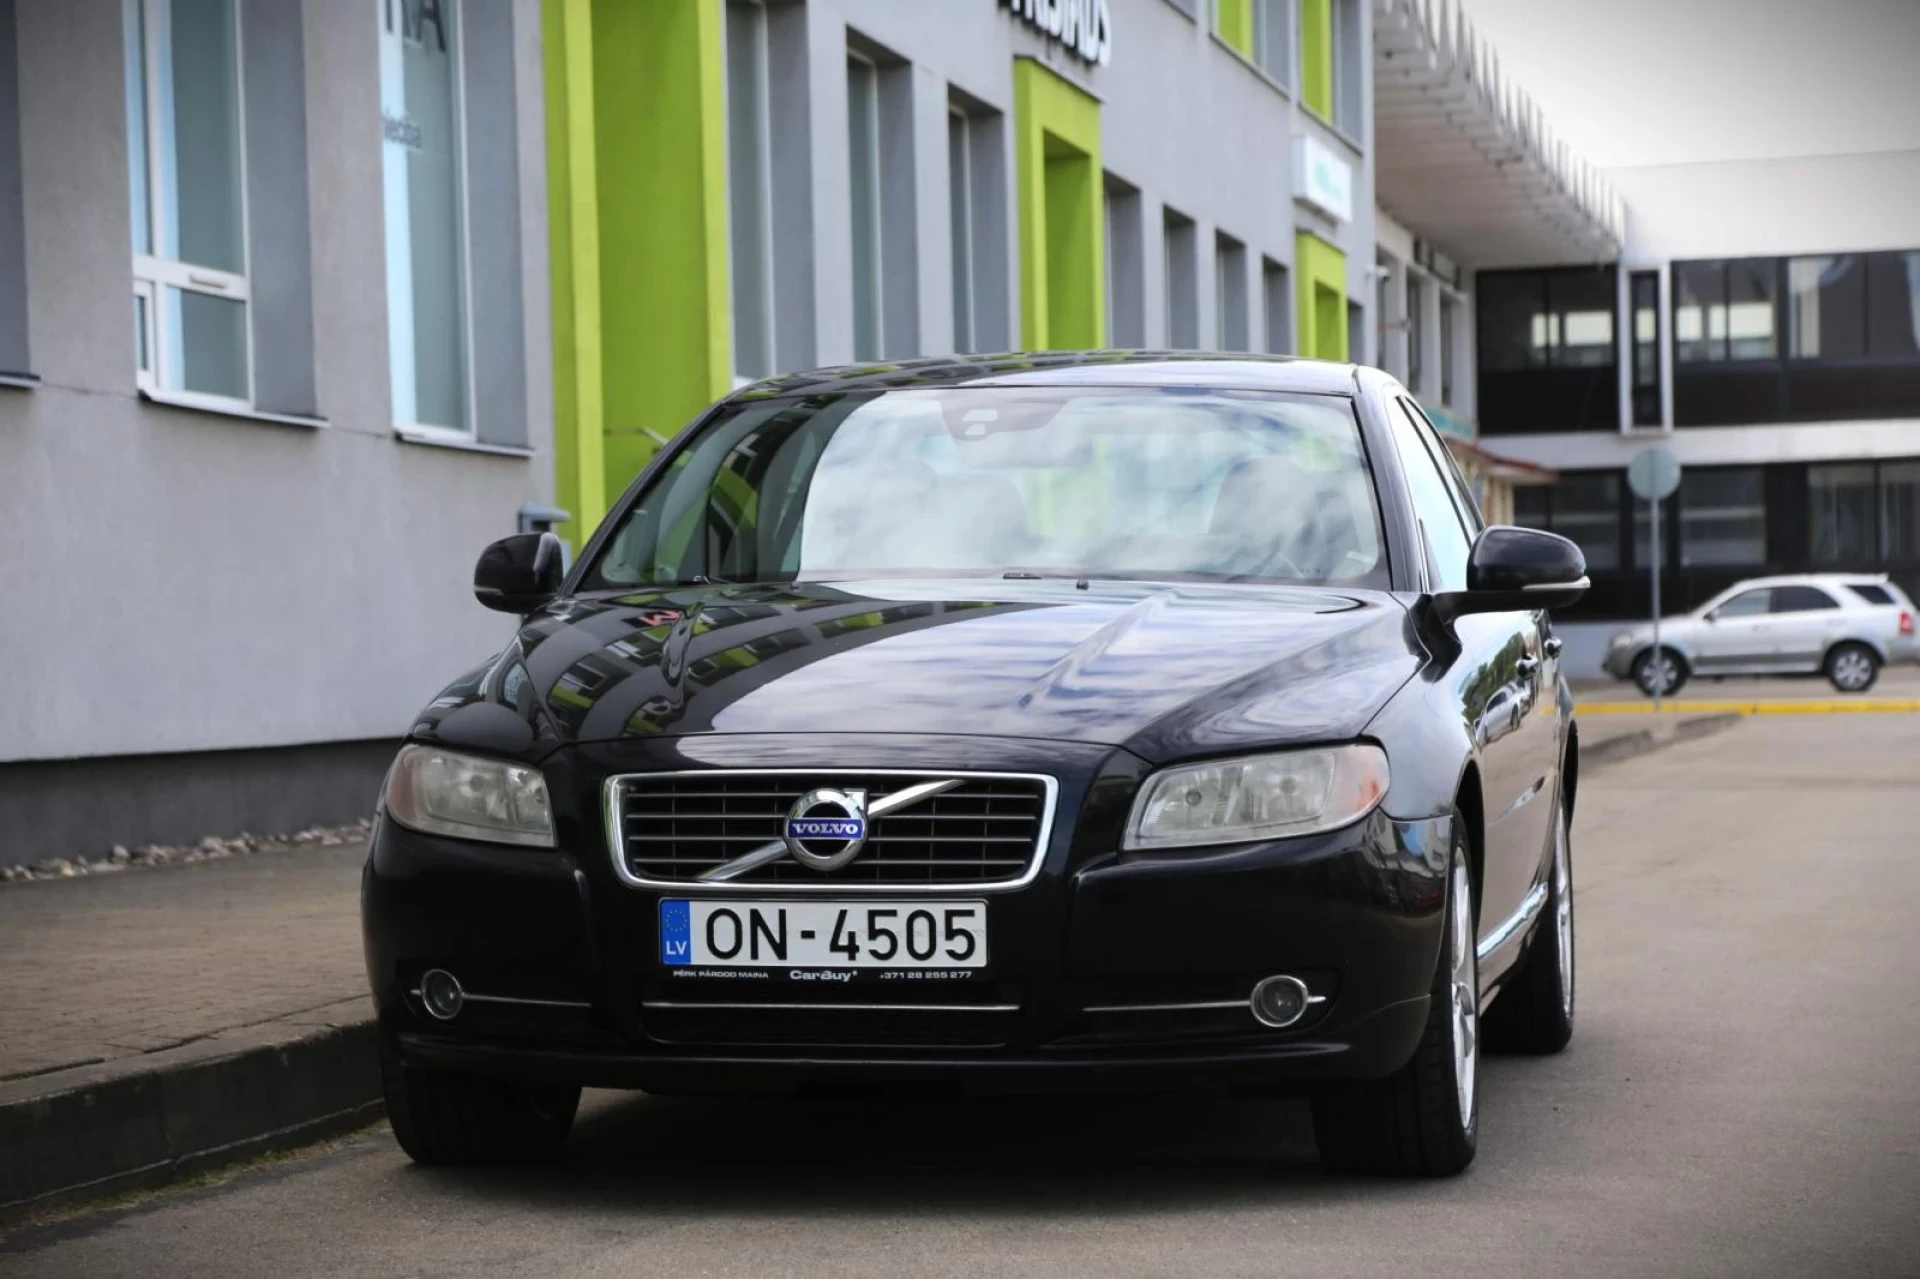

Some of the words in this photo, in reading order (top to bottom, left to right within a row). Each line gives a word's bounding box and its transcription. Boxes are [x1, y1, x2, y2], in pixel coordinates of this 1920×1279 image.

[792, 823, 858, 834] VOLVO
[706, 908, 976, 961] ON-4505
[666, 941, 686, 955] LV
[950, 971, 972, 979] 277
